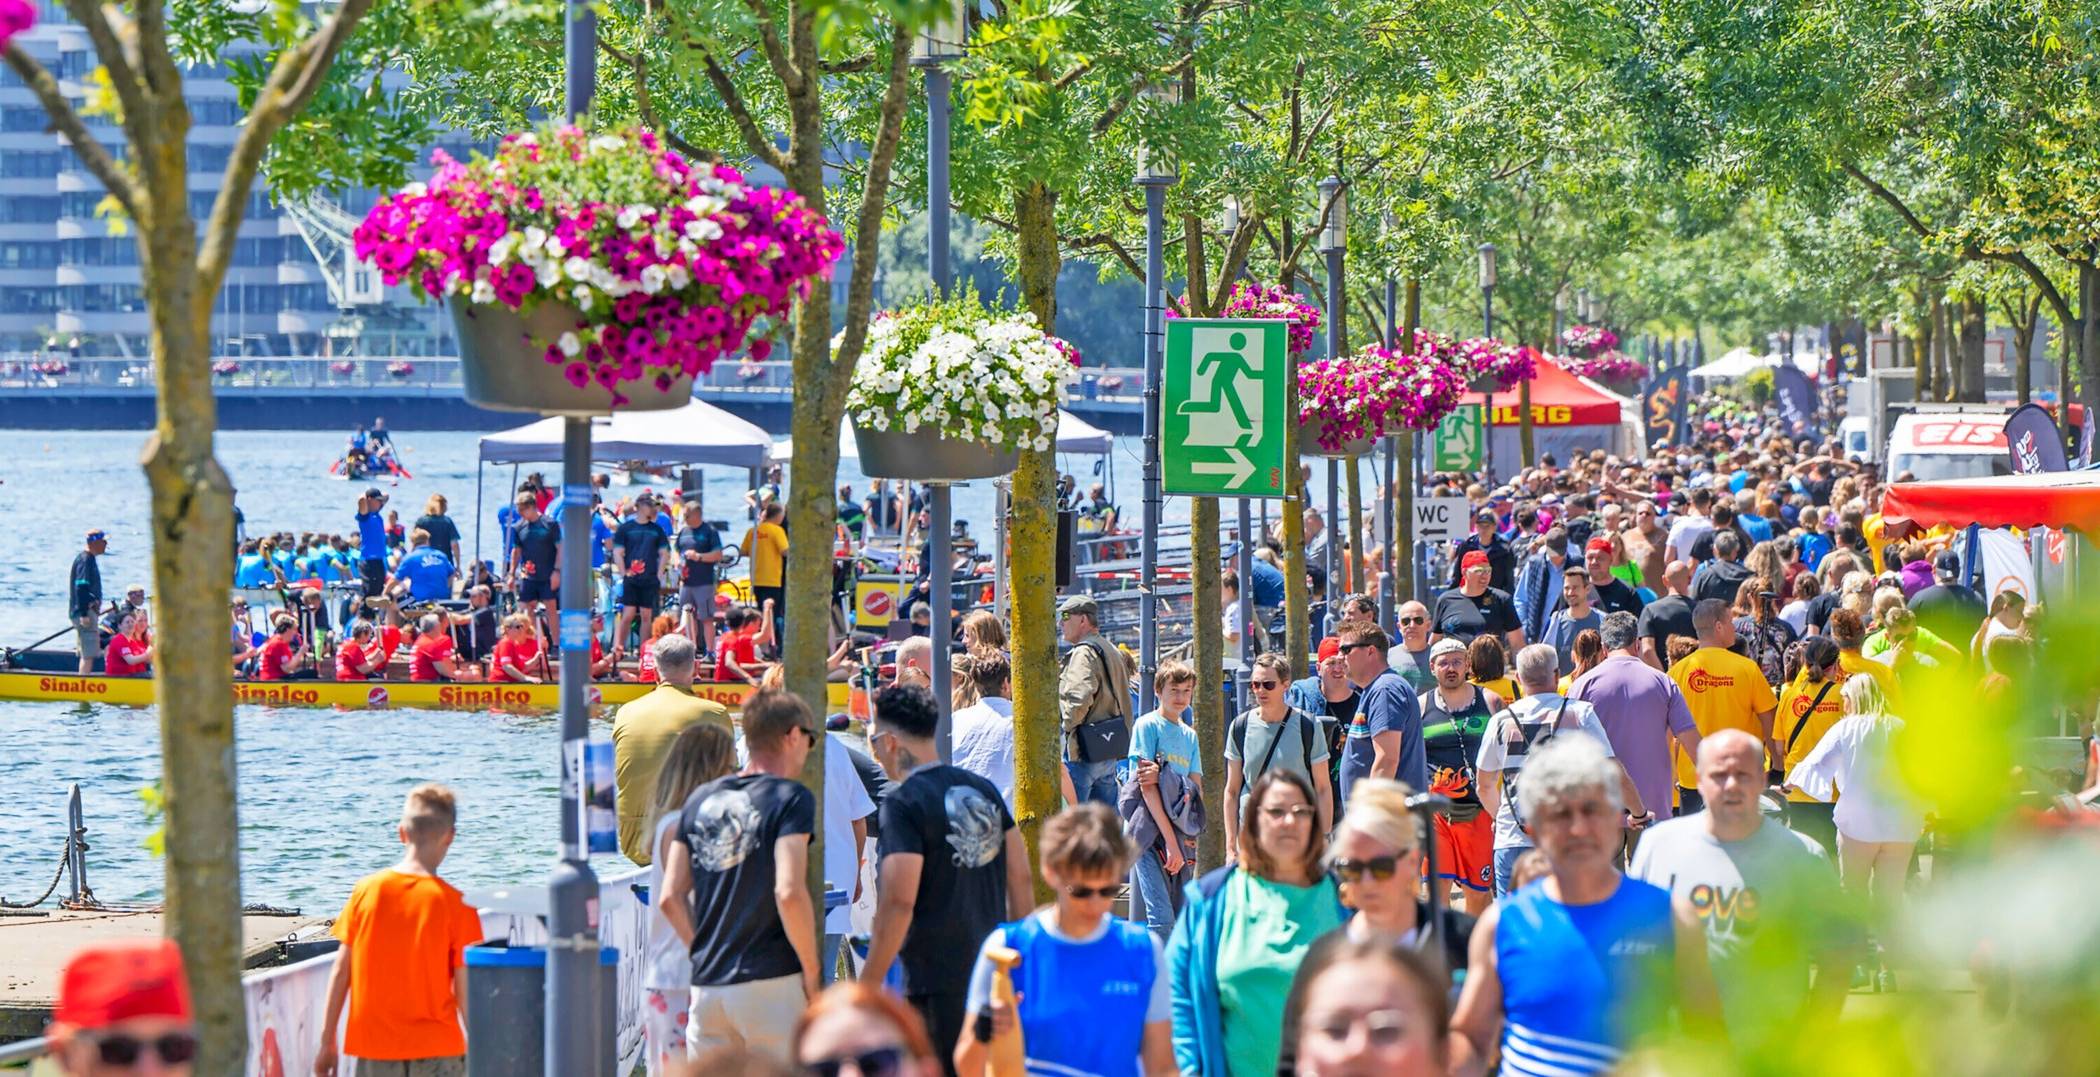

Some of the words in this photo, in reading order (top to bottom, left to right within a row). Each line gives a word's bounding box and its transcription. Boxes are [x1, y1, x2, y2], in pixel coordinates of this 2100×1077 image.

[1919, 424, 1997, 443] EIS
[1417, 505, 1449, 524] WC
[40, 677, 107, 694] Sinalco
[1697, 679, 1734, 688] Dragons
[439, 686, 531, 706] Sinalco
[1800, 703, 1840, 713] Dagons
